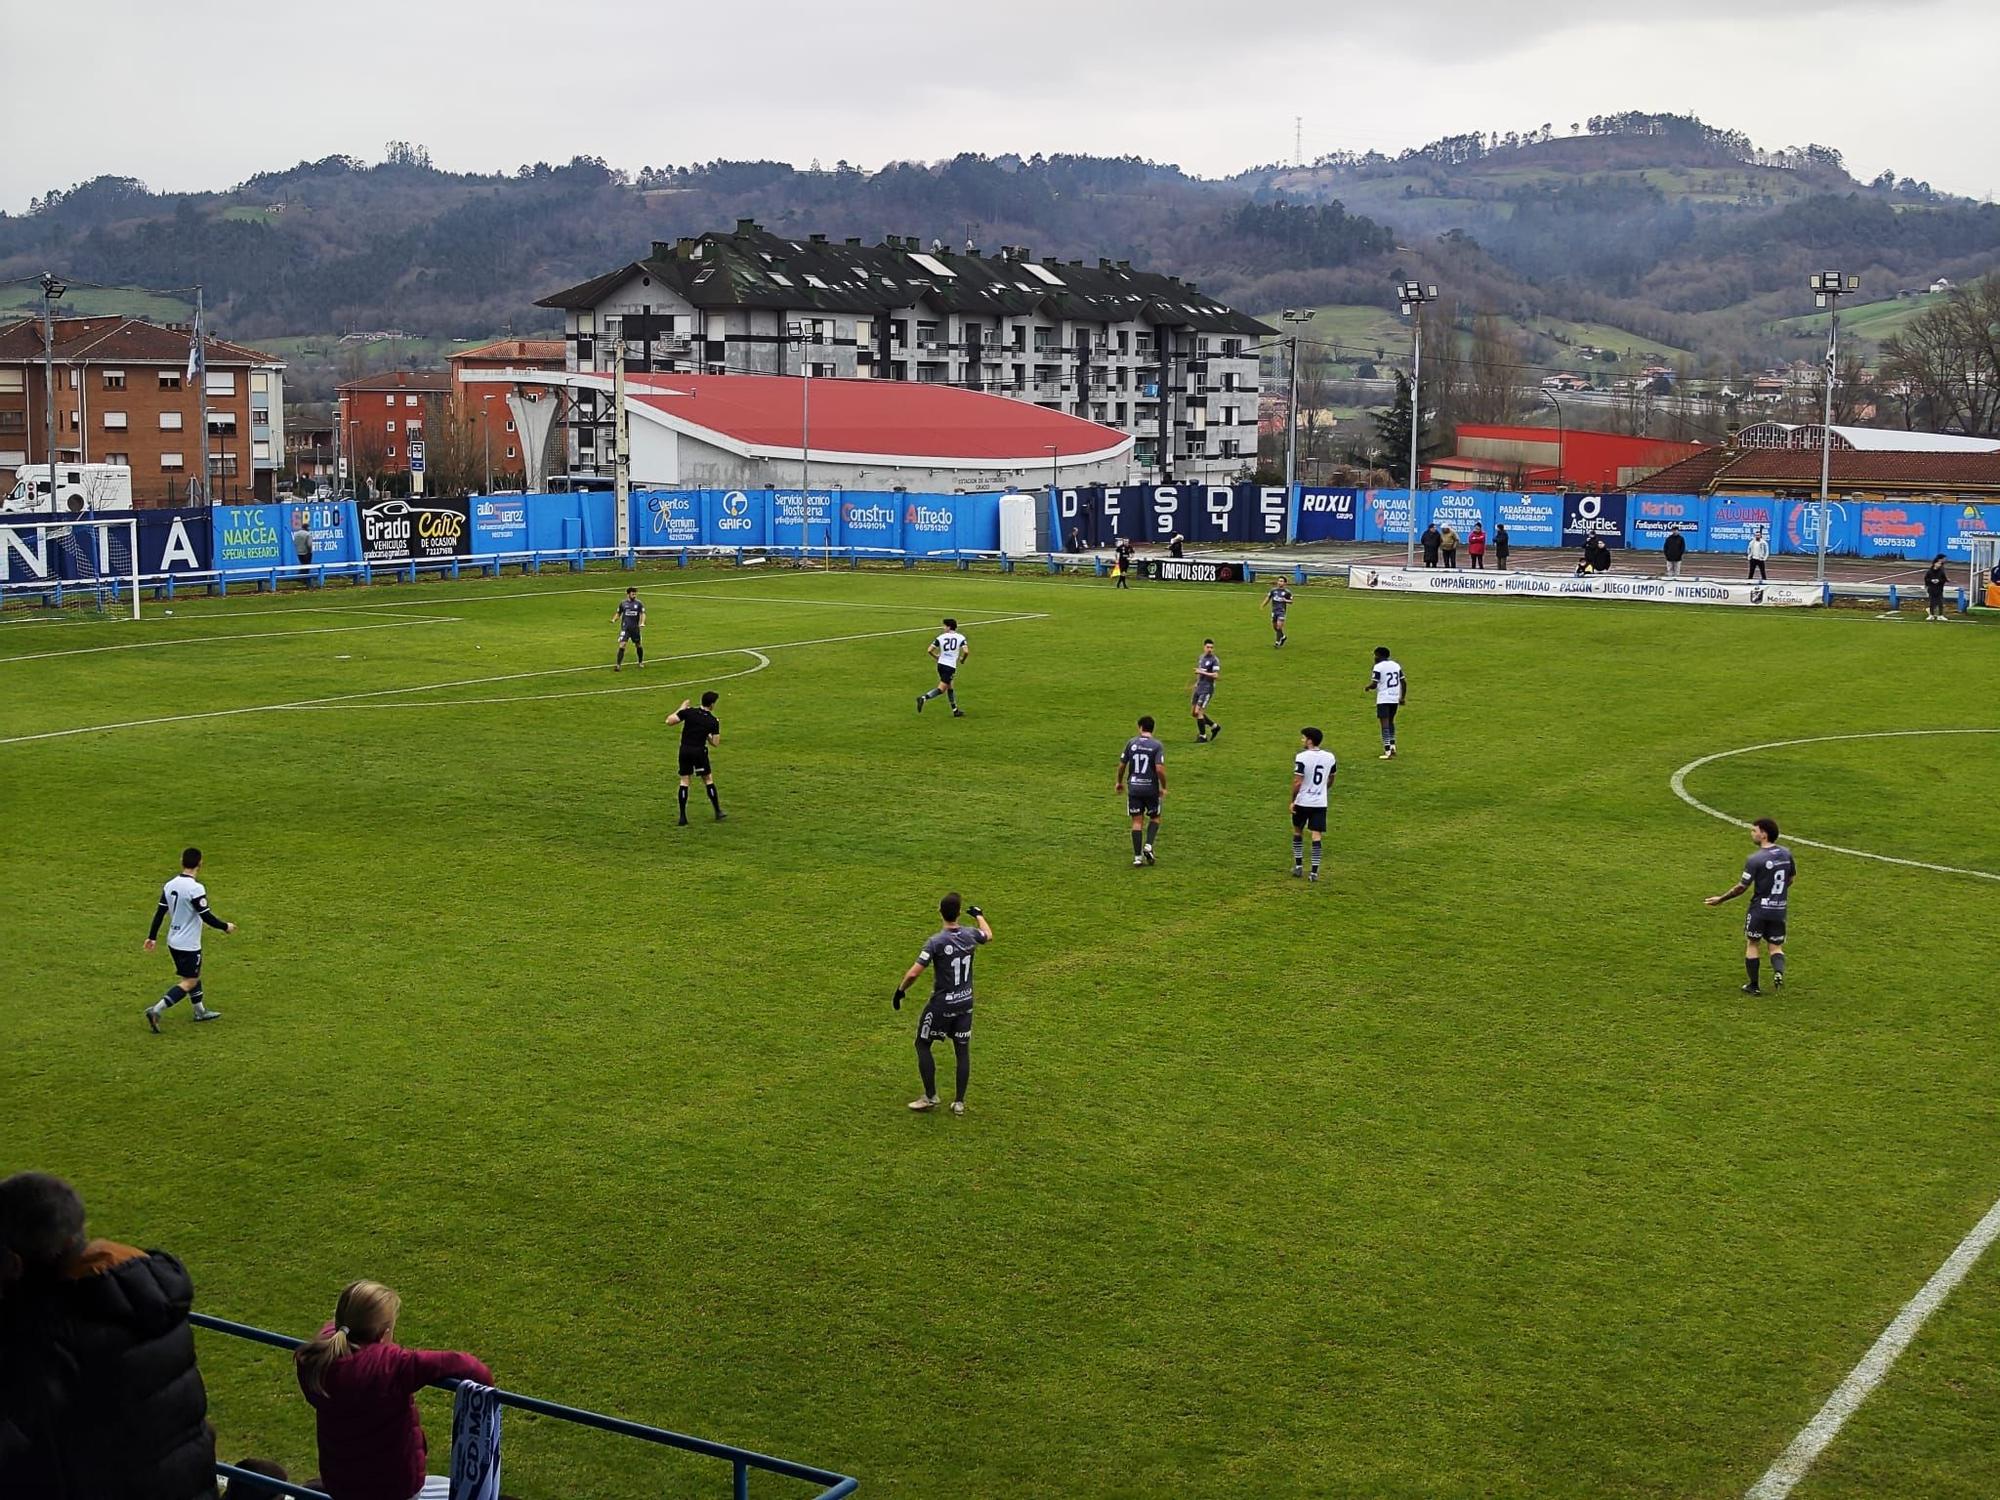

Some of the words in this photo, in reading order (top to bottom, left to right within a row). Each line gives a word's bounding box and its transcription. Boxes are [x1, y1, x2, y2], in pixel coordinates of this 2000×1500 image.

[648, 498, 690, 512] eventos
[774, 494, 802, 505] Servicio
[806, 495, 830, 505] ecnico
[1302, 494, 1352, 512] ROXU
[1441, 495, 1474, 507] GRADO
[842, 503, 894, 523] Constru
[904, 504, 952, 524] Alfredo
[1433, 507, 1481, 520] ASISTENCIA
[365, 516, 410, 541] Grado
[418, 512, 462, 538] Cars
[718, 518, 751, 530] GRIFO
[1570, 518, 1617, 530] AsturElec
[224, 528, 278, 545] NARCEA
[421, 539, 429, 548] DE
[222, 549, 247, 560] SPECIAL
[247, 546, 279, 559] RESEARCH
[373, 540, 407, 550] VEHICULOS
[1162, 562, 1216, 581] IMPULSO23
[1429, 576, 1496, 590] COMPAÑERISMO
[1505, 578, 1550, 592] HUMILDAD
[1560, 578, 1593, 593] PASIÓN
[1602, 583, 1630, 594] JUEGO
[1632, 584, 1665, 597] LIMPIO
[1674, 586, 1729, 600] INTENSIDAD
[943, 638, 957, 651] 20
[1386, 672, 1398, 688] 23
[1132, 753, 1149, 774] 17
[1313, 765, 1324, 786] 6
[1771, 869, 1785, 894] 8
[951, 955, 971, 986] 11
